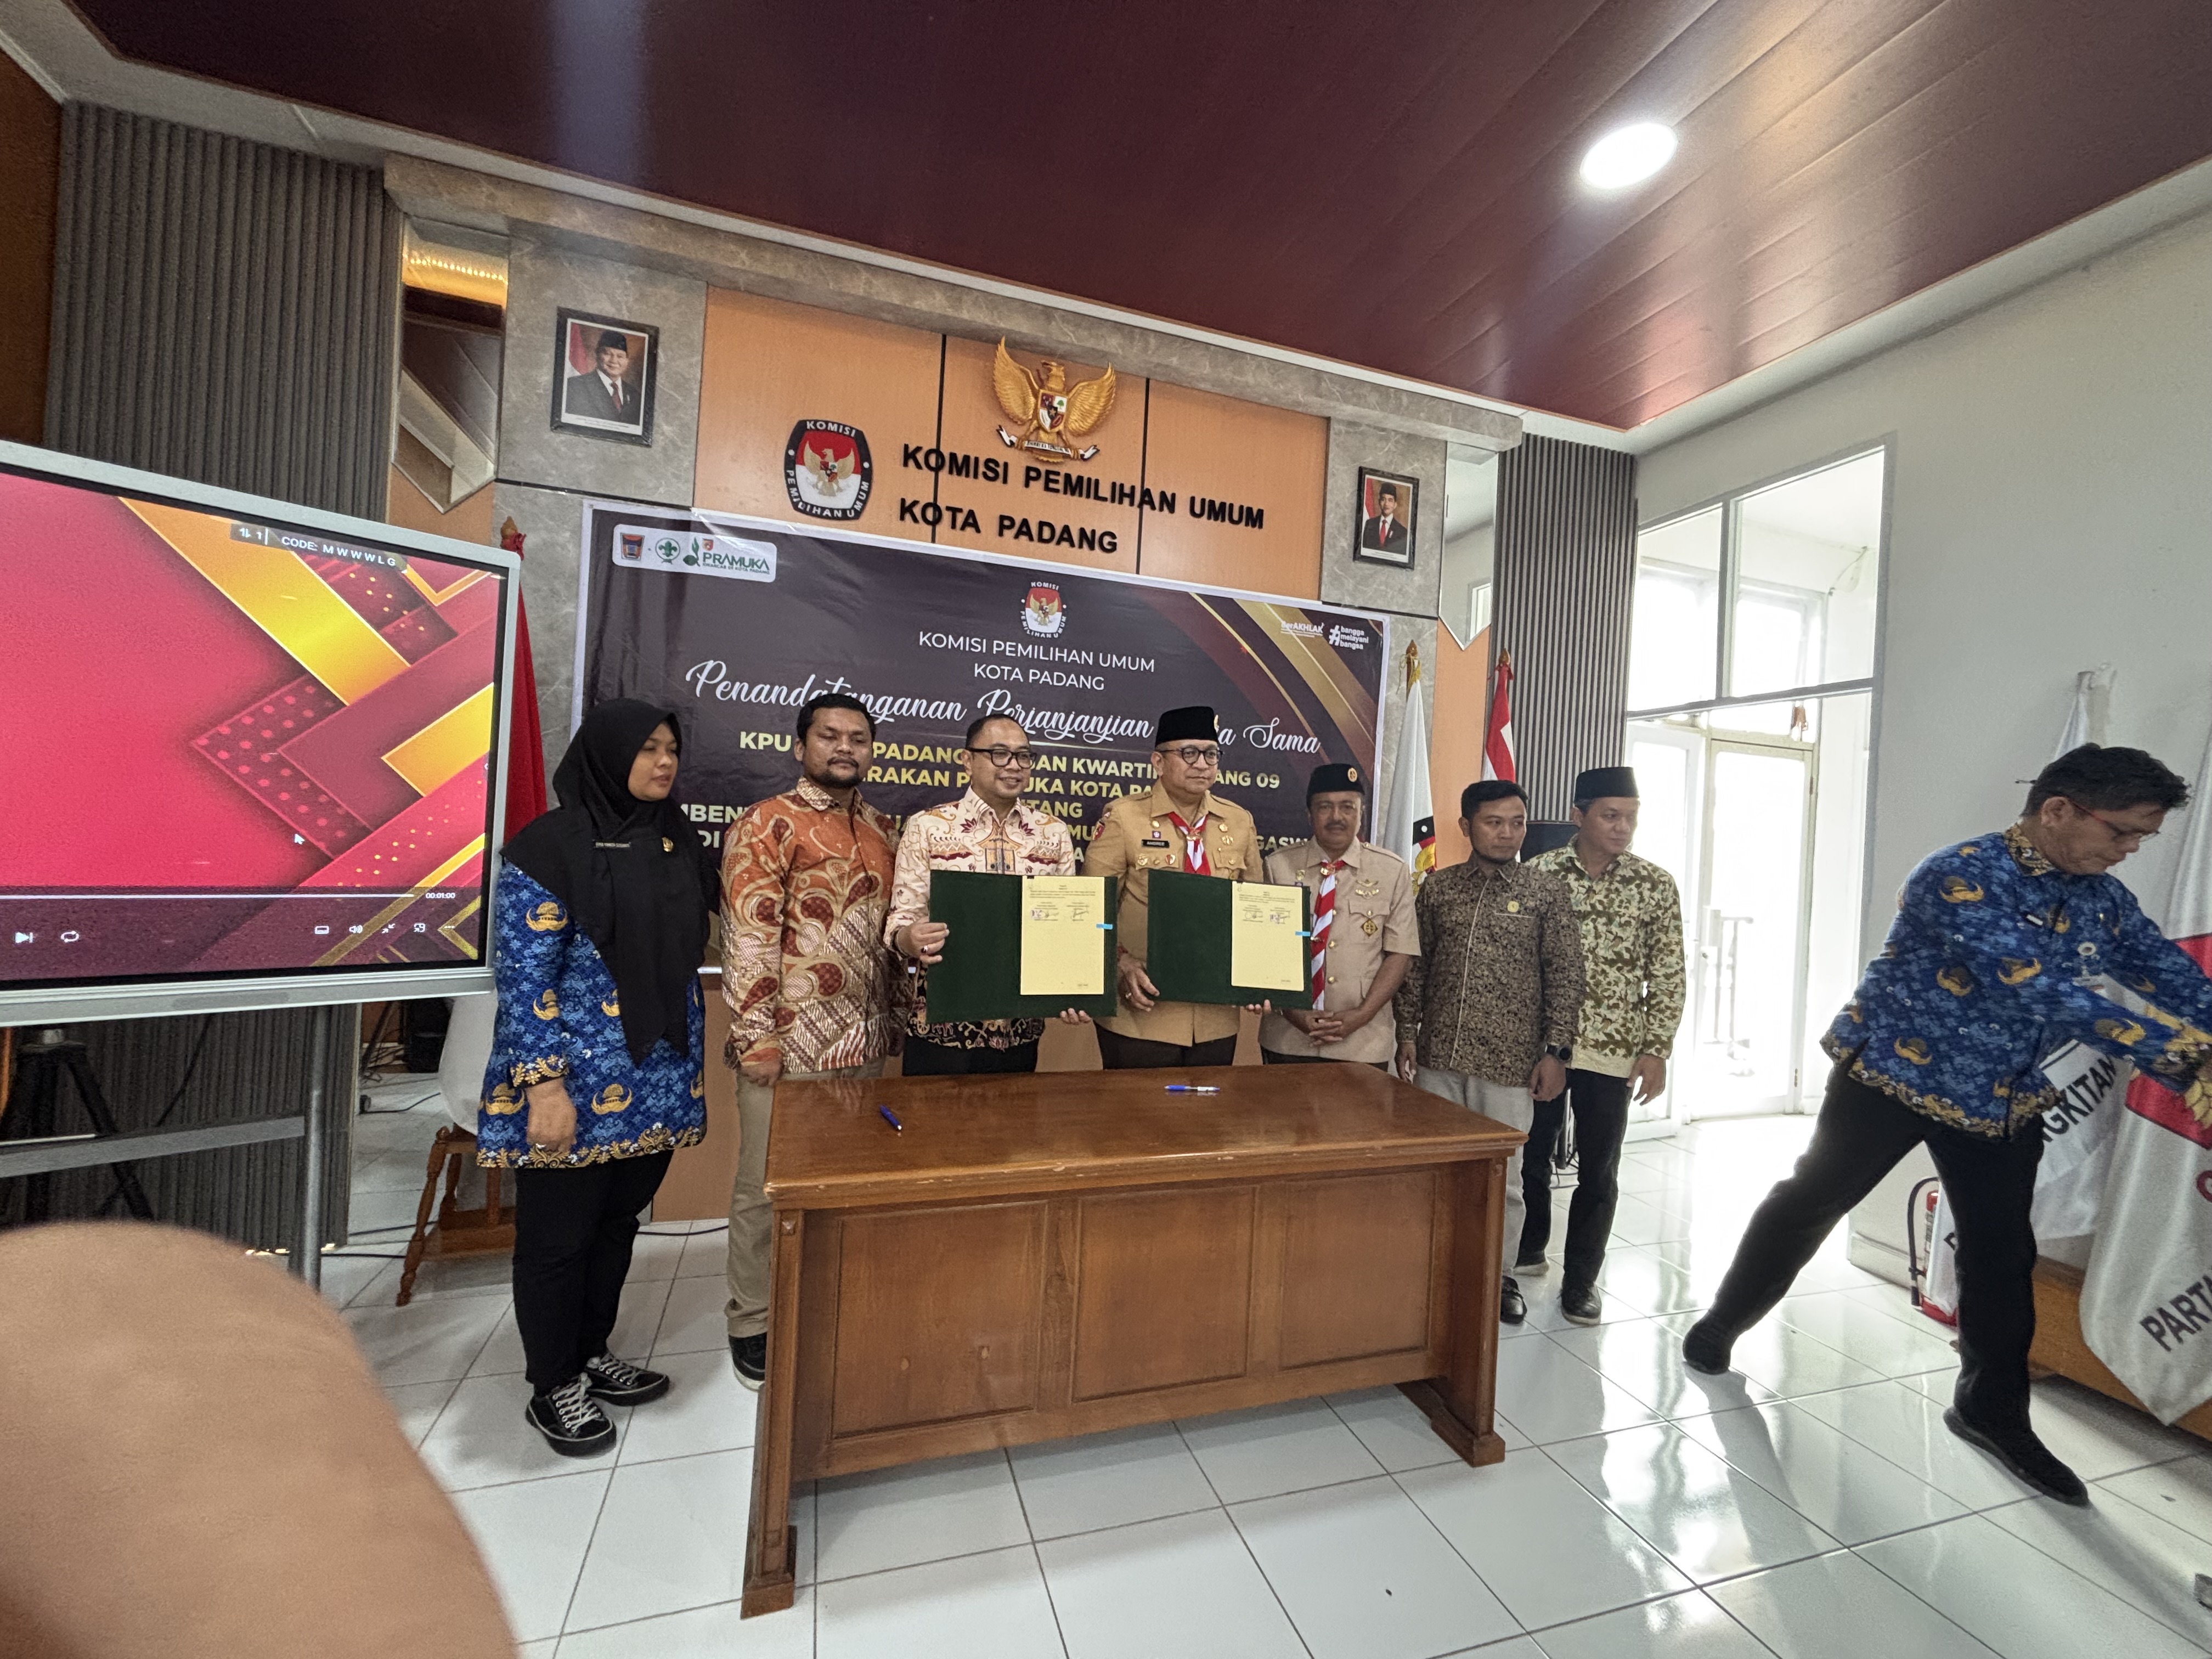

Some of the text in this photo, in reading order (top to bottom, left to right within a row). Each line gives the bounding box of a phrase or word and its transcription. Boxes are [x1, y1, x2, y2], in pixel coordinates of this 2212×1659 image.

[806, 420, 857, 437] KOMISI
[786, 470, 870, 517] PEMILIHAN UMUM
[903, 443, 1264, 529] KOMISI PEMILIHAN UMUM
[900, 498, 1117, 554] KOTA PADANG
[703, 552, 770, 571] PRAMUKA
[1030, 581, 1059, 591] KOMISI
[919, 631, 1155, 673] KOMISI PEMILIHAN UMUM
[974, 663, 1105, 691] KOTA PADANG
[1243, 717, 1321, 754] Sama
[740, 731, 792, 753] KPU
[1256, 772, 1280, 789] 09
[862, 766, 950, 788] RAKAN
[1070, 779, 1123, 798] KOTA
[2140, 1274, 2212, 1352] PART
